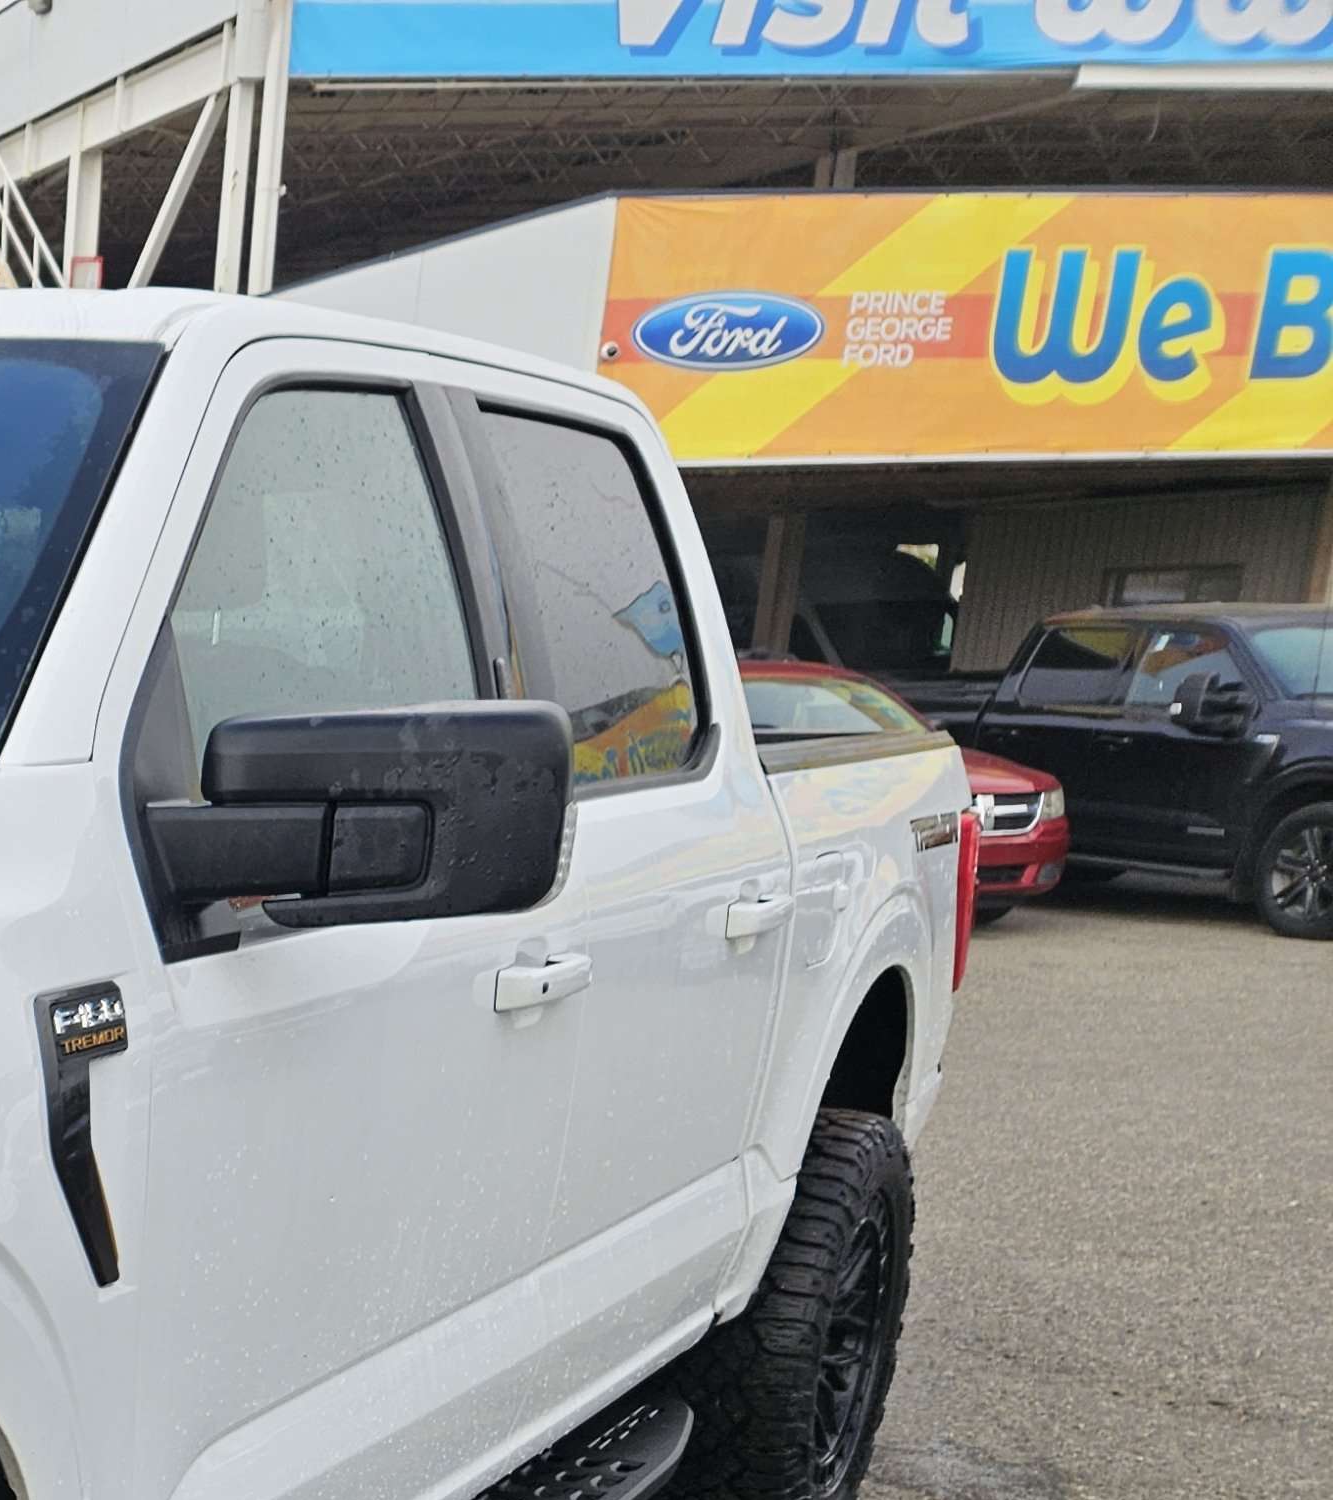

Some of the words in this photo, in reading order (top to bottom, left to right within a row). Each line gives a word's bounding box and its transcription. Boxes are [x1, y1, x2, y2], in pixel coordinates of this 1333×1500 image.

[849, 290, 947, 316] PRINCE
[992, 246, 1213, 385] We
[668, 301, 789, 358] Ford
[845, 316, 954, 341] GEORGE
[842, 344, 915, 369] FORD
[61, 1026, 126, 1054] TREMOR
